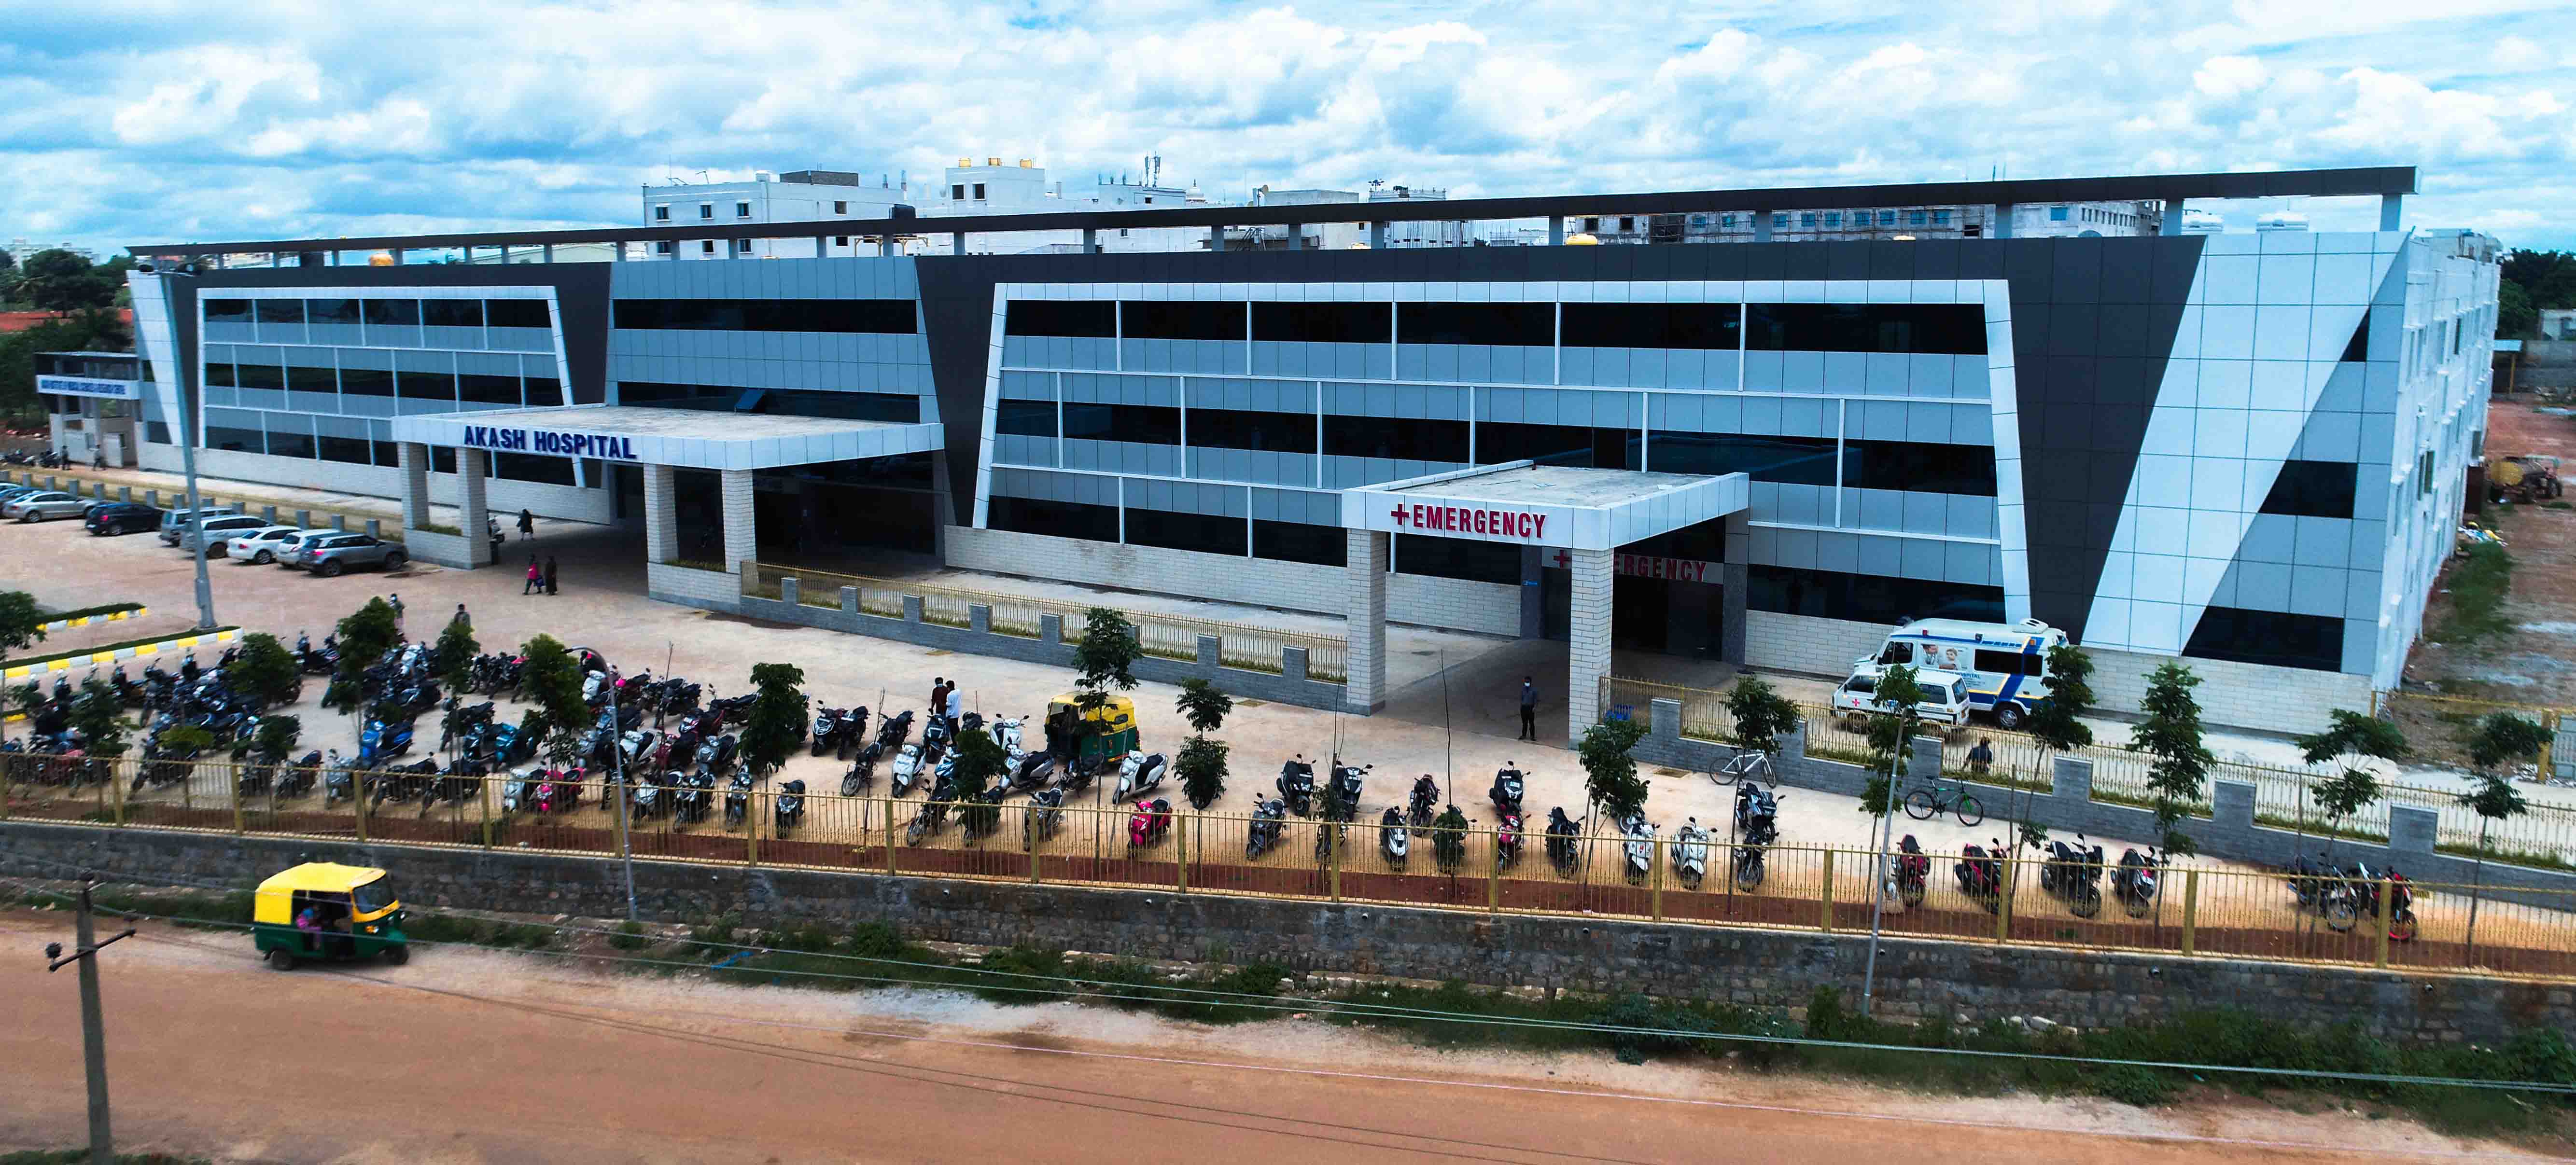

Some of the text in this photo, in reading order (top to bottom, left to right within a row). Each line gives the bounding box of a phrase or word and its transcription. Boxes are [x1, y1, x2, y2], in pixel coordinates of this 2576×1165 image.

[464, 425, 637, 459] AKASH HOSPITAL
[1413, 504, 1546, 538] EMERGENCY
[1614, 555, 1707, 582] ERGENCY
